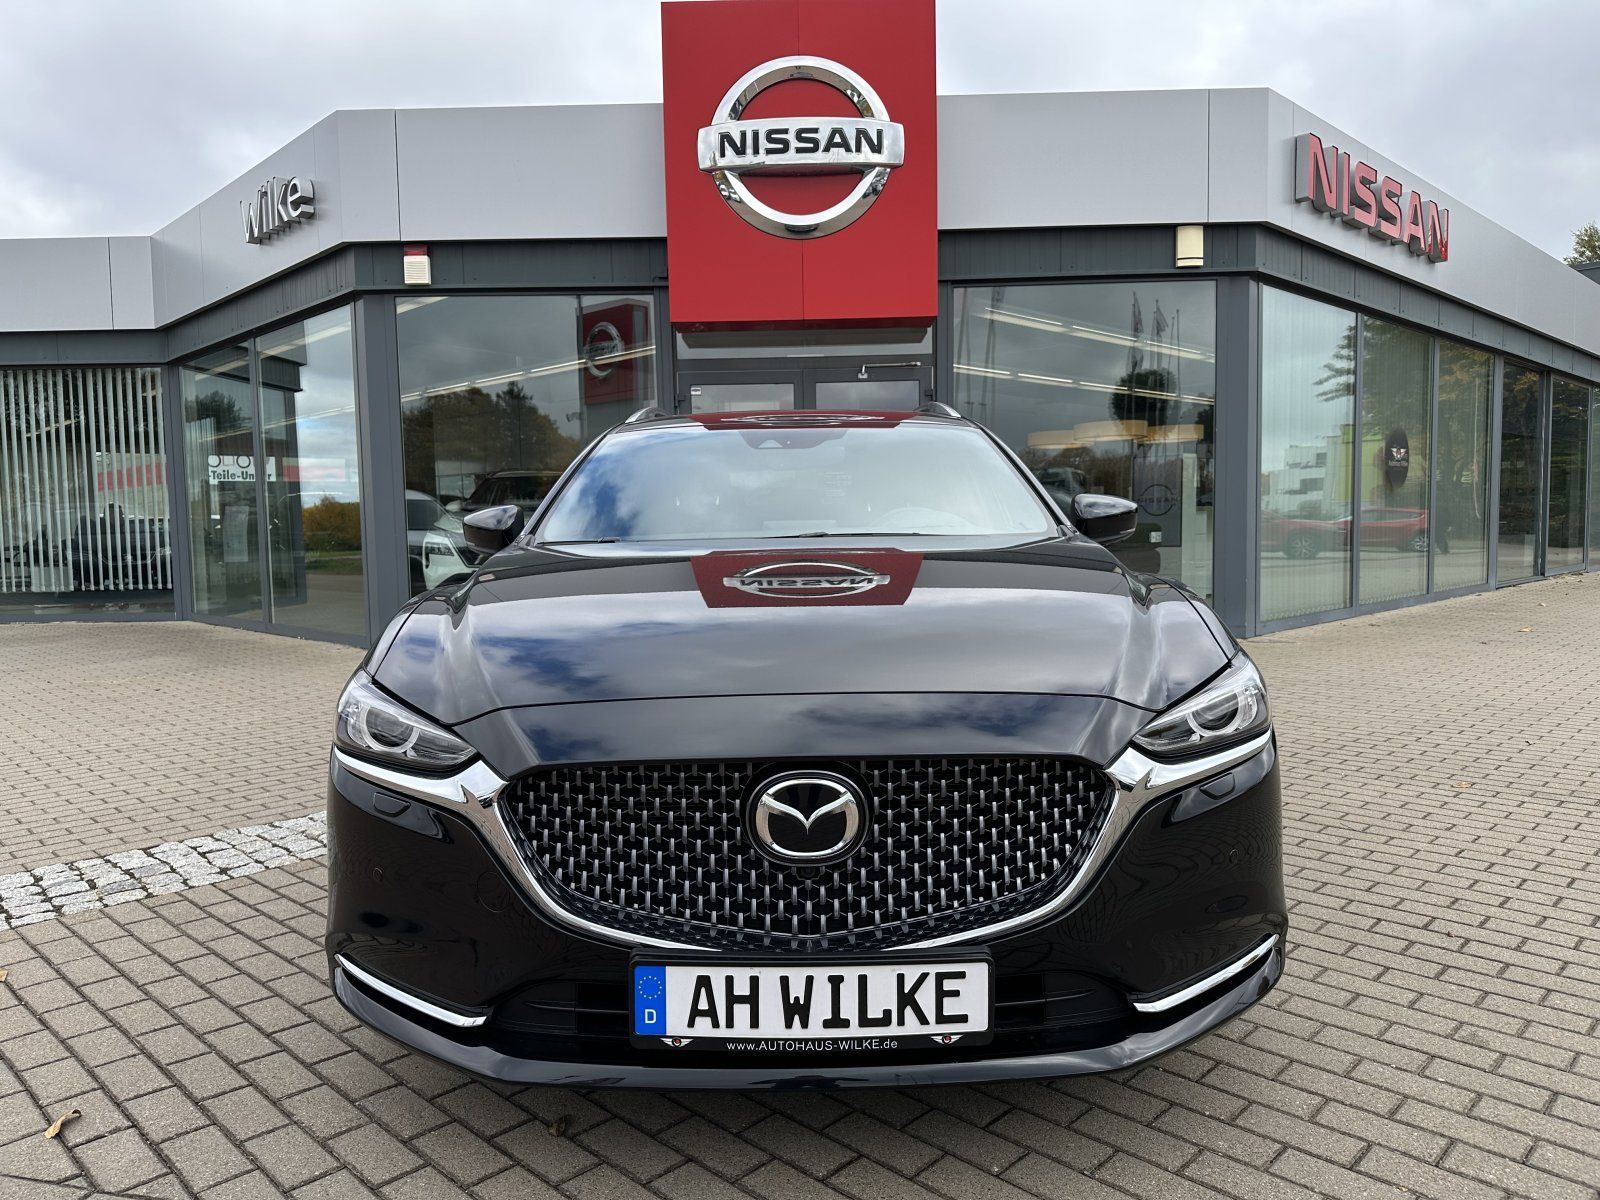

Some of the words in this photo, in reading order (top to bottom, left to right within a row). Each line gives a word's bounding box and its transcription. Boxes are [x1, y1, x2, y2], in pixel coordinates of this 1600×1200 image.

[718, 127, 883, 158] NISSAN
[240, 176, 315, 244] Wilke
[1302, 132, 1450, 262] NISSAN
[644, 1008, 657, 1024] D
[686, 975, 760, 1029] AH
[779, 970, 969, 1030] WILKE
[726, 1038, 898, 1051] www.AUTOHAUS-WILKE.de
